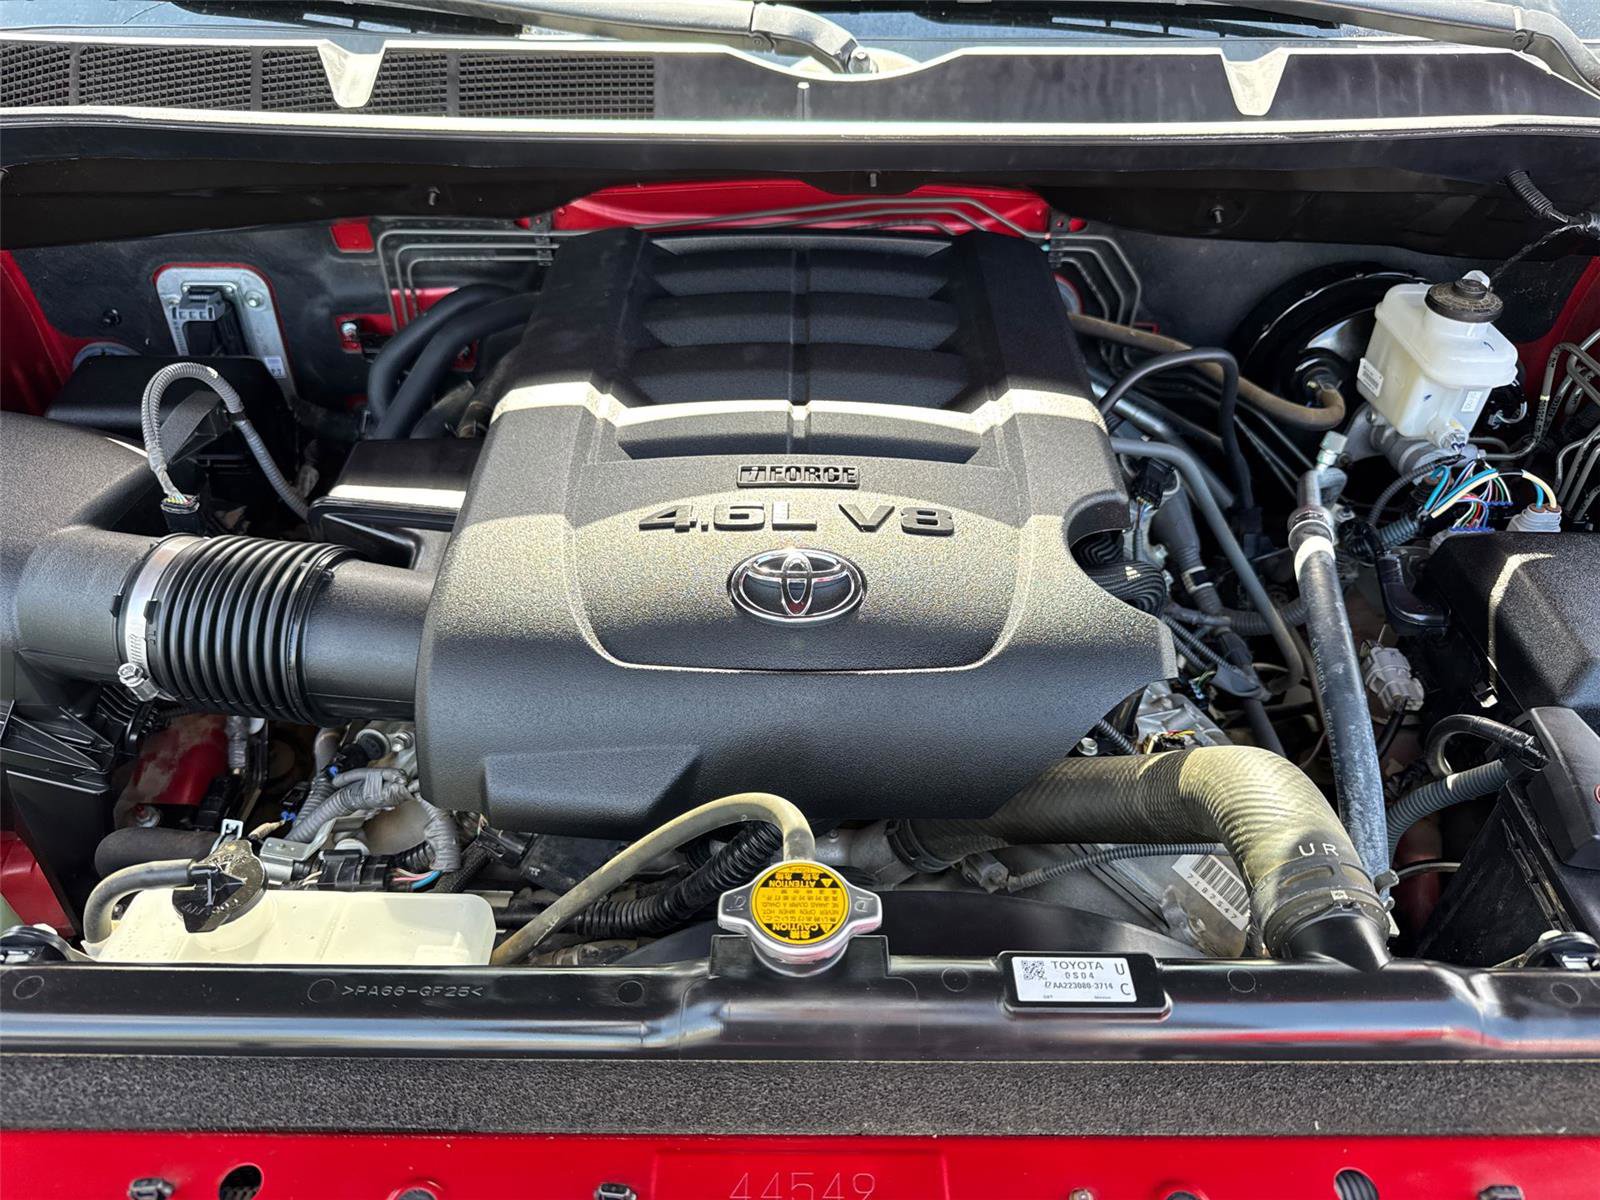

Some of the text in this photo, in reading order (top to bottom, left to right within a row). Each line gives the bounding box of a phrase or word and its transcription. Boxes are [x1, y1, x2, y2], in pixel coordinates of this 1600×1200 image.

[639, 502, 955, 537] 4.6L V8
[773, 923, 818, 931] CAUTION
[1051, 960, 1126, 976] TOYOTA U
[1120, 982, 1132, 996] C
[729, 1172, 876, 1200] 44549
